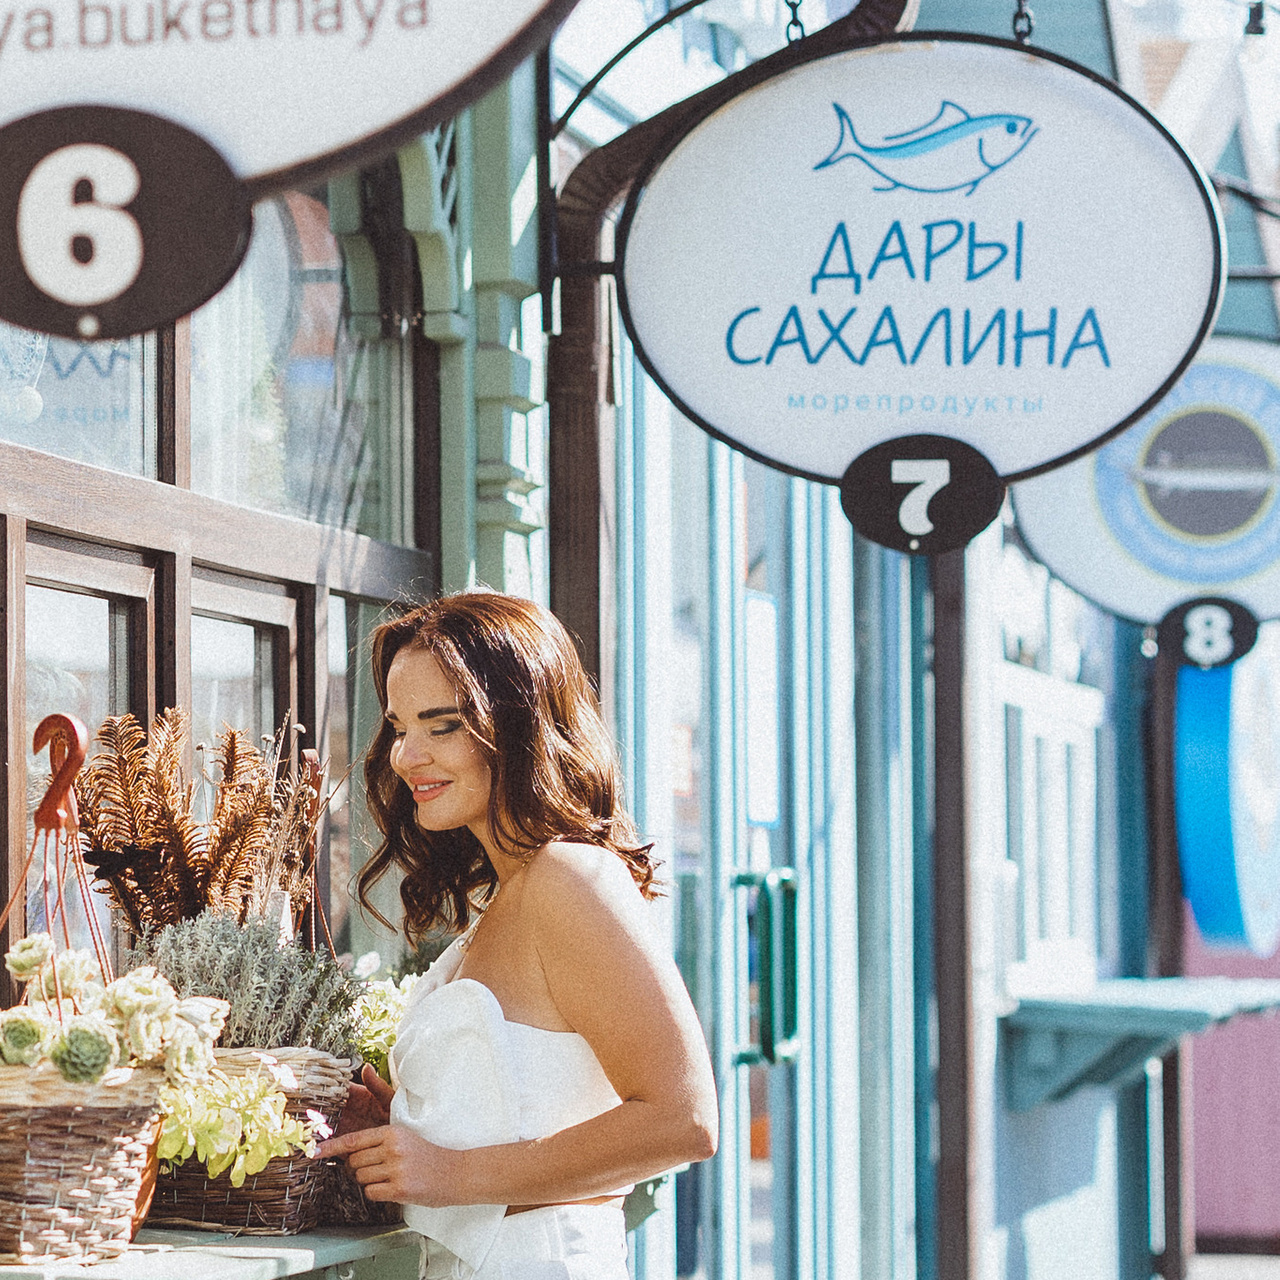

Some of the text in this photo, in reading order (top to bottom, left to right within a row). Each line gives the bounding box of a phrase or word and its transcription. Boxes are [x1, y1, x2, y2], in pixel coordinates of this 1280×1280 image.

[16, 141, 145, 308] 6
[811, 219, 1024, 295] ДАРЫ
[725, 304, 1112, 369] САХАЛИНА
[787, 392, 1045, 417] морепродукты
[890, 458, 951, 536] 7
[1182, 603, 1235, 665] 8
